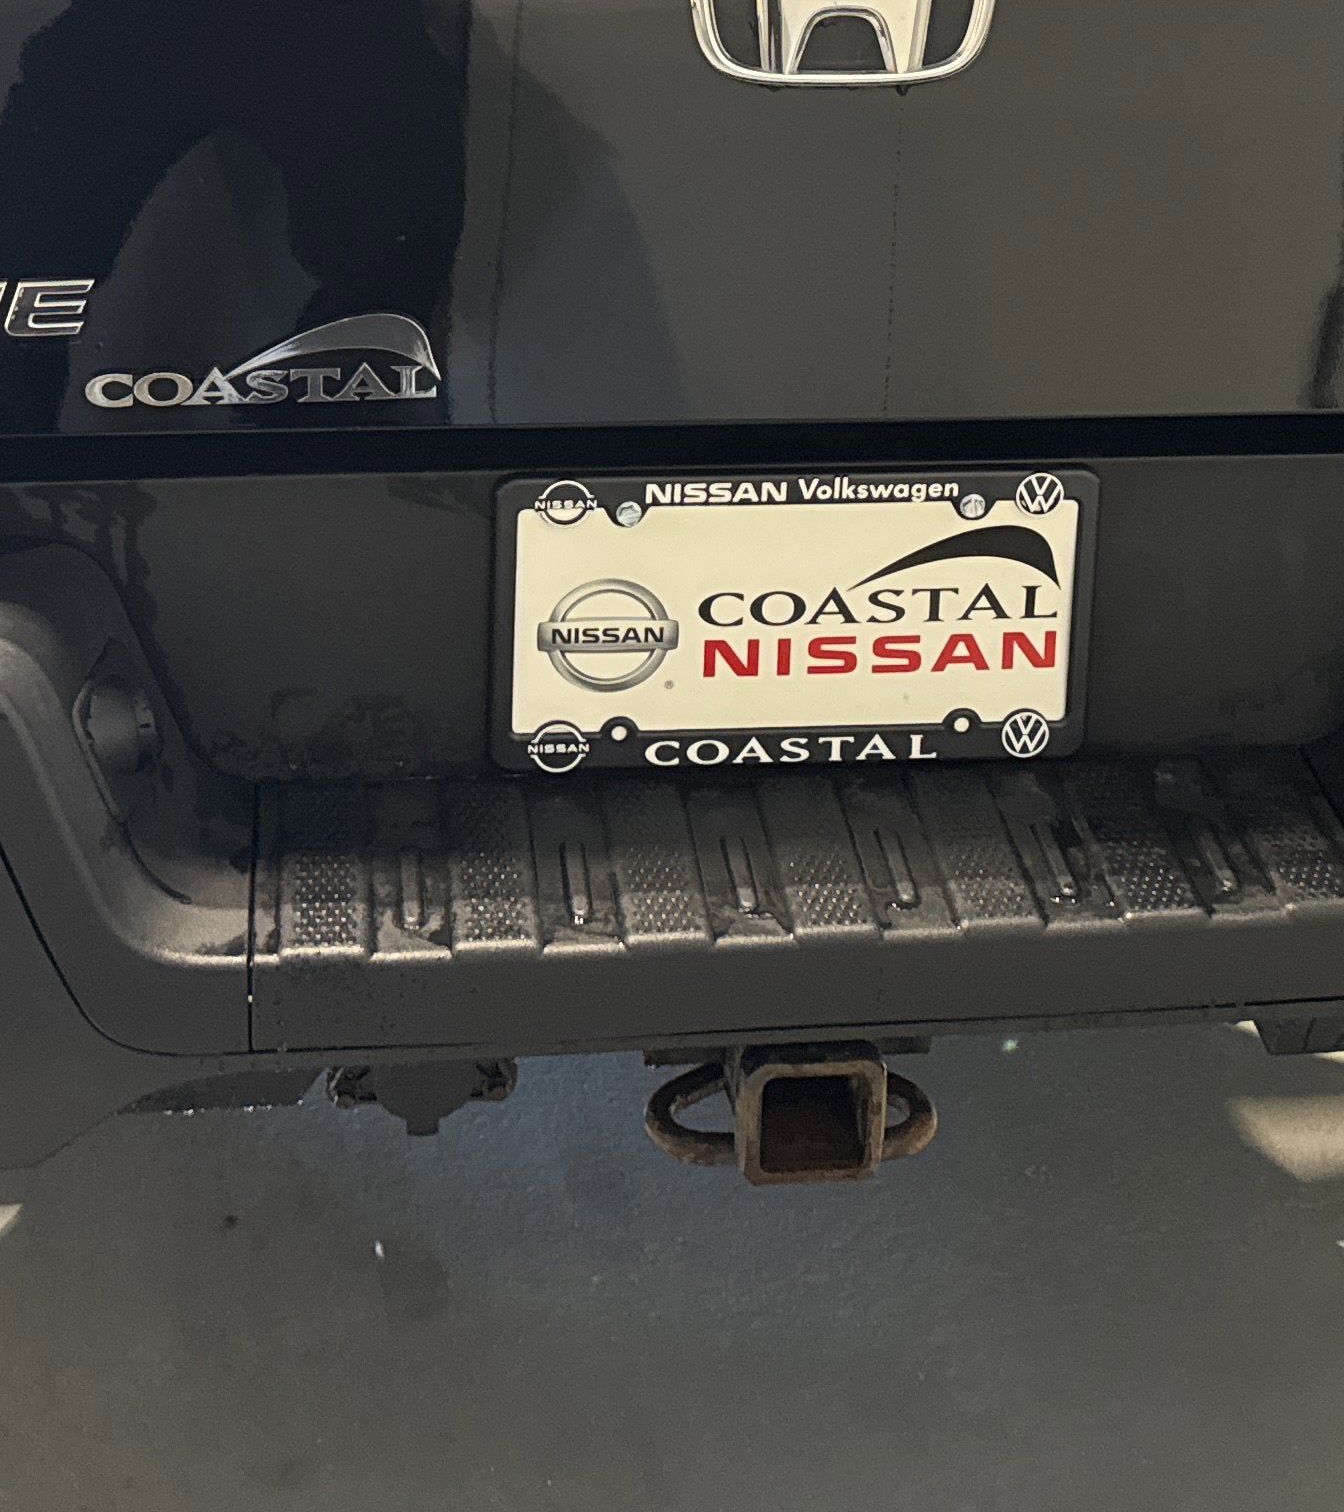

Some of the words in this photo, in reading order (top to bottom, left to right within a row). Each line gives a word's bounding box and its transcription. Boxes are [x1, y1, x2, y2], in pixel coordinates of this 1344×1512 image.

[84, 364, 442, 410] COASTAL
[534, 498, 598, 512] NISSAN
[645, 482, 788, 505] NISSAN
[798, 477, 959, 502] Volkswagen
[697, 583, 1058, 628] COASTAL
[551, 626, 665, 645] NISSAN
[702, 631, 1058, 678] NISSAN
[527, 742, 590, 755] NISSAN
[644, 734, 938, 767] COASTAL
